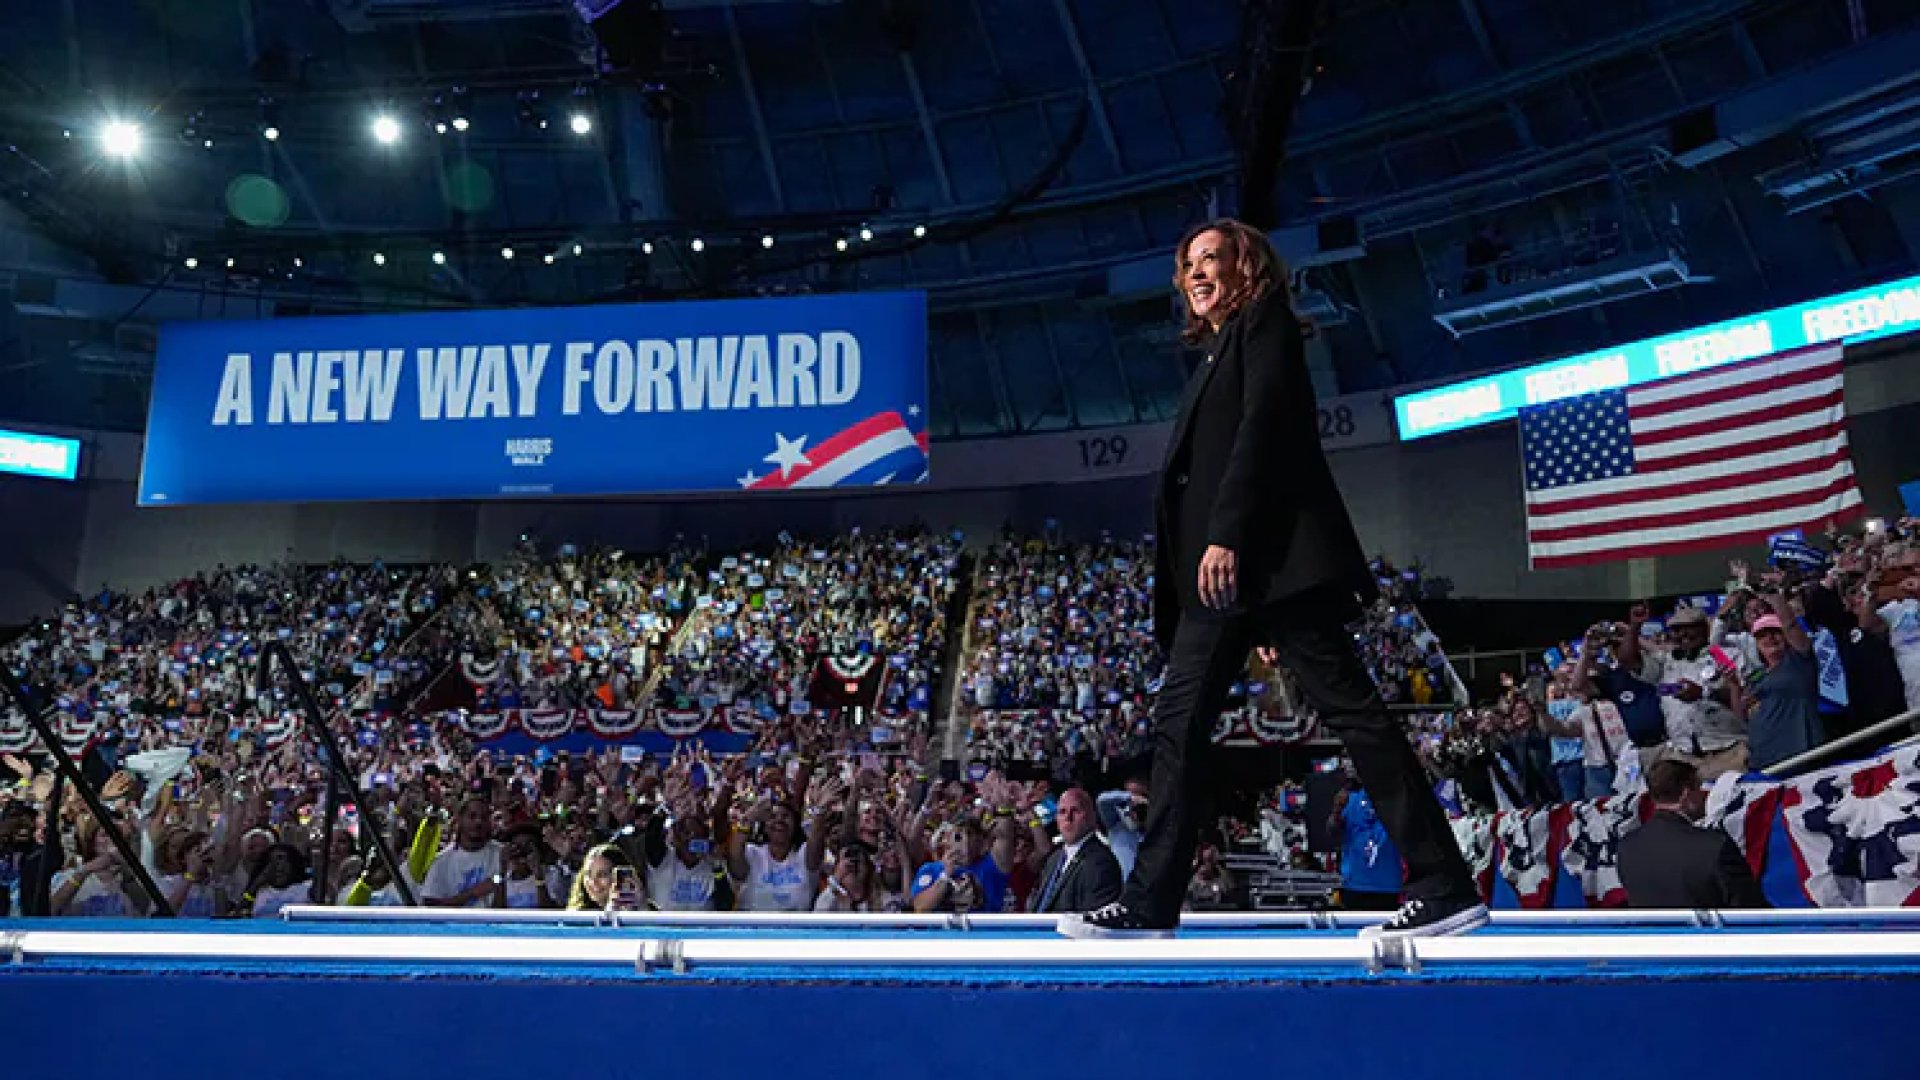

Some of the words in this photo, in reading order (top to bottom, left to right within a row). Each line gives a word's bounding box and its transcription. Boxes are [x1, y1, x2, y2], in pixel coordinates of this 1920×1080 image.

[212, 353, 252, 426] A
[267, 348, 406, 423] NEW
[416, 343, 551, 420] WAY
[562, 331, 861, 415] FORWARD
[1317, 404, 1355, 438] 28
[1077, 435, 1126, 467] 129
